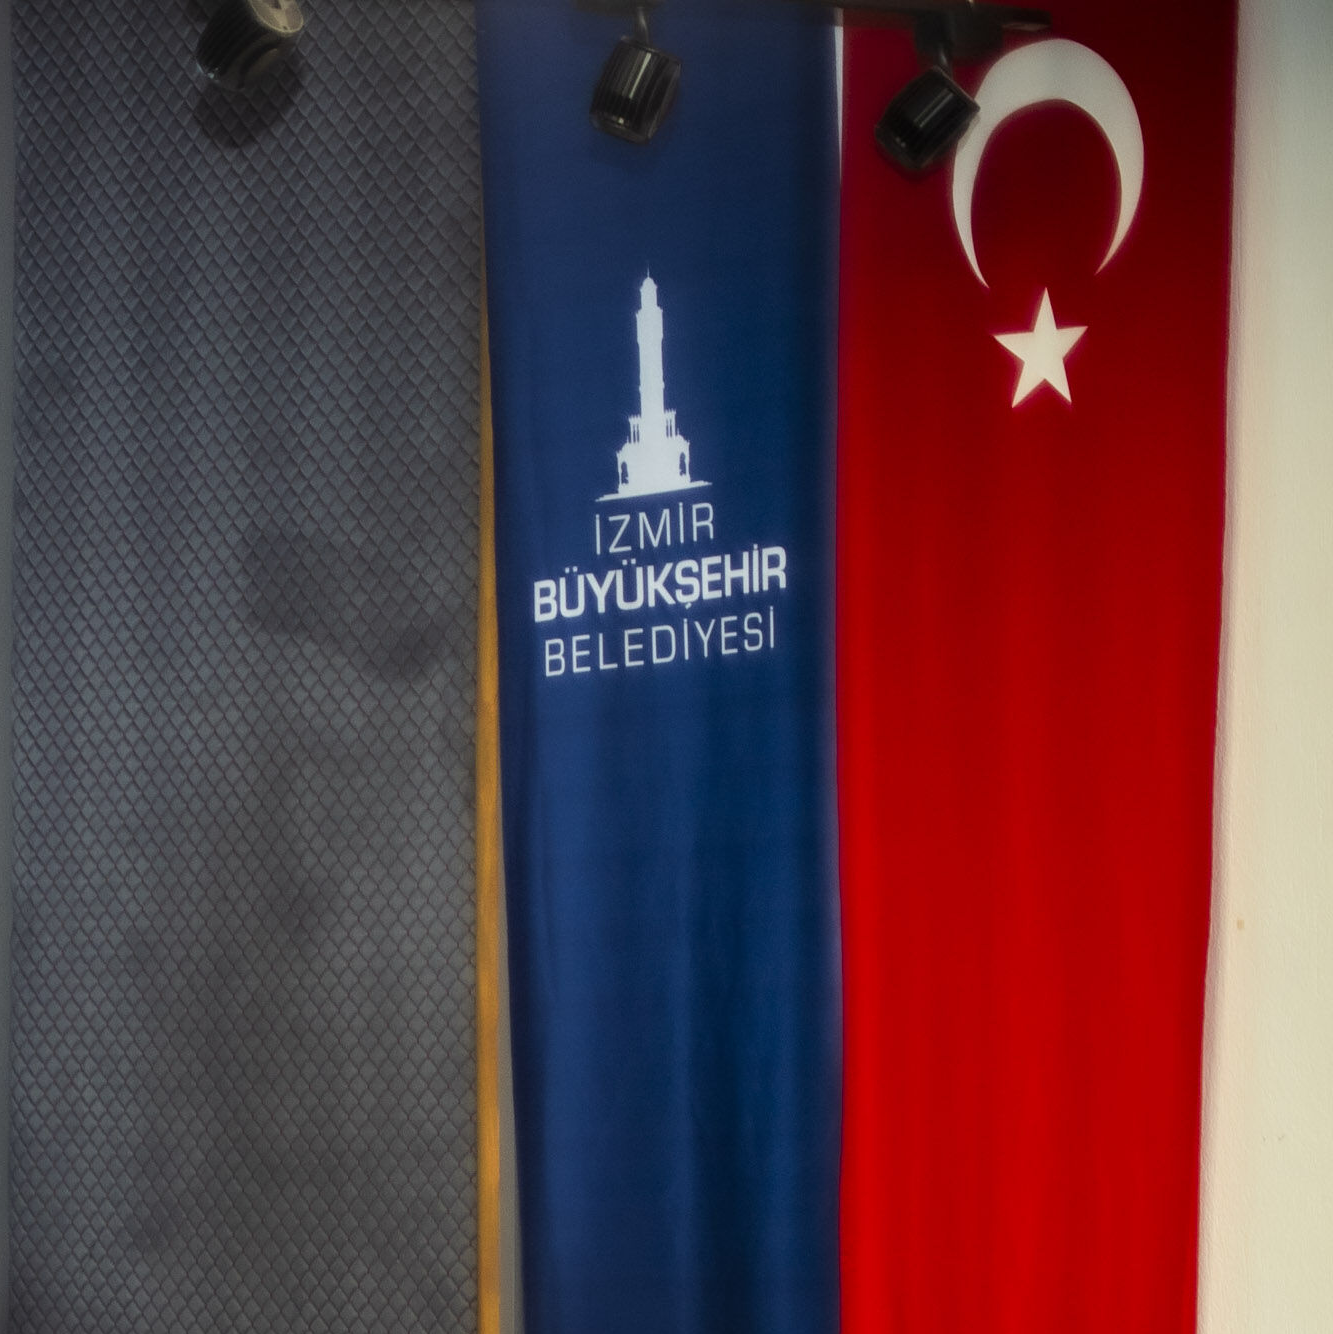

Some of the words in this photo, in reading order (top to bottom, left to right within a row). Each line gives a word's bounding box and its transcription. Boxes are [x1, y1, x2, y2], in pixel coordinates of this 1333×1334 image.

[595, 501, 715, 556] İZMİR
[534, 543, 787, 623] BÜYÜKŞEHİR
[545, 606, 775, 677] BELEDİYESİ
